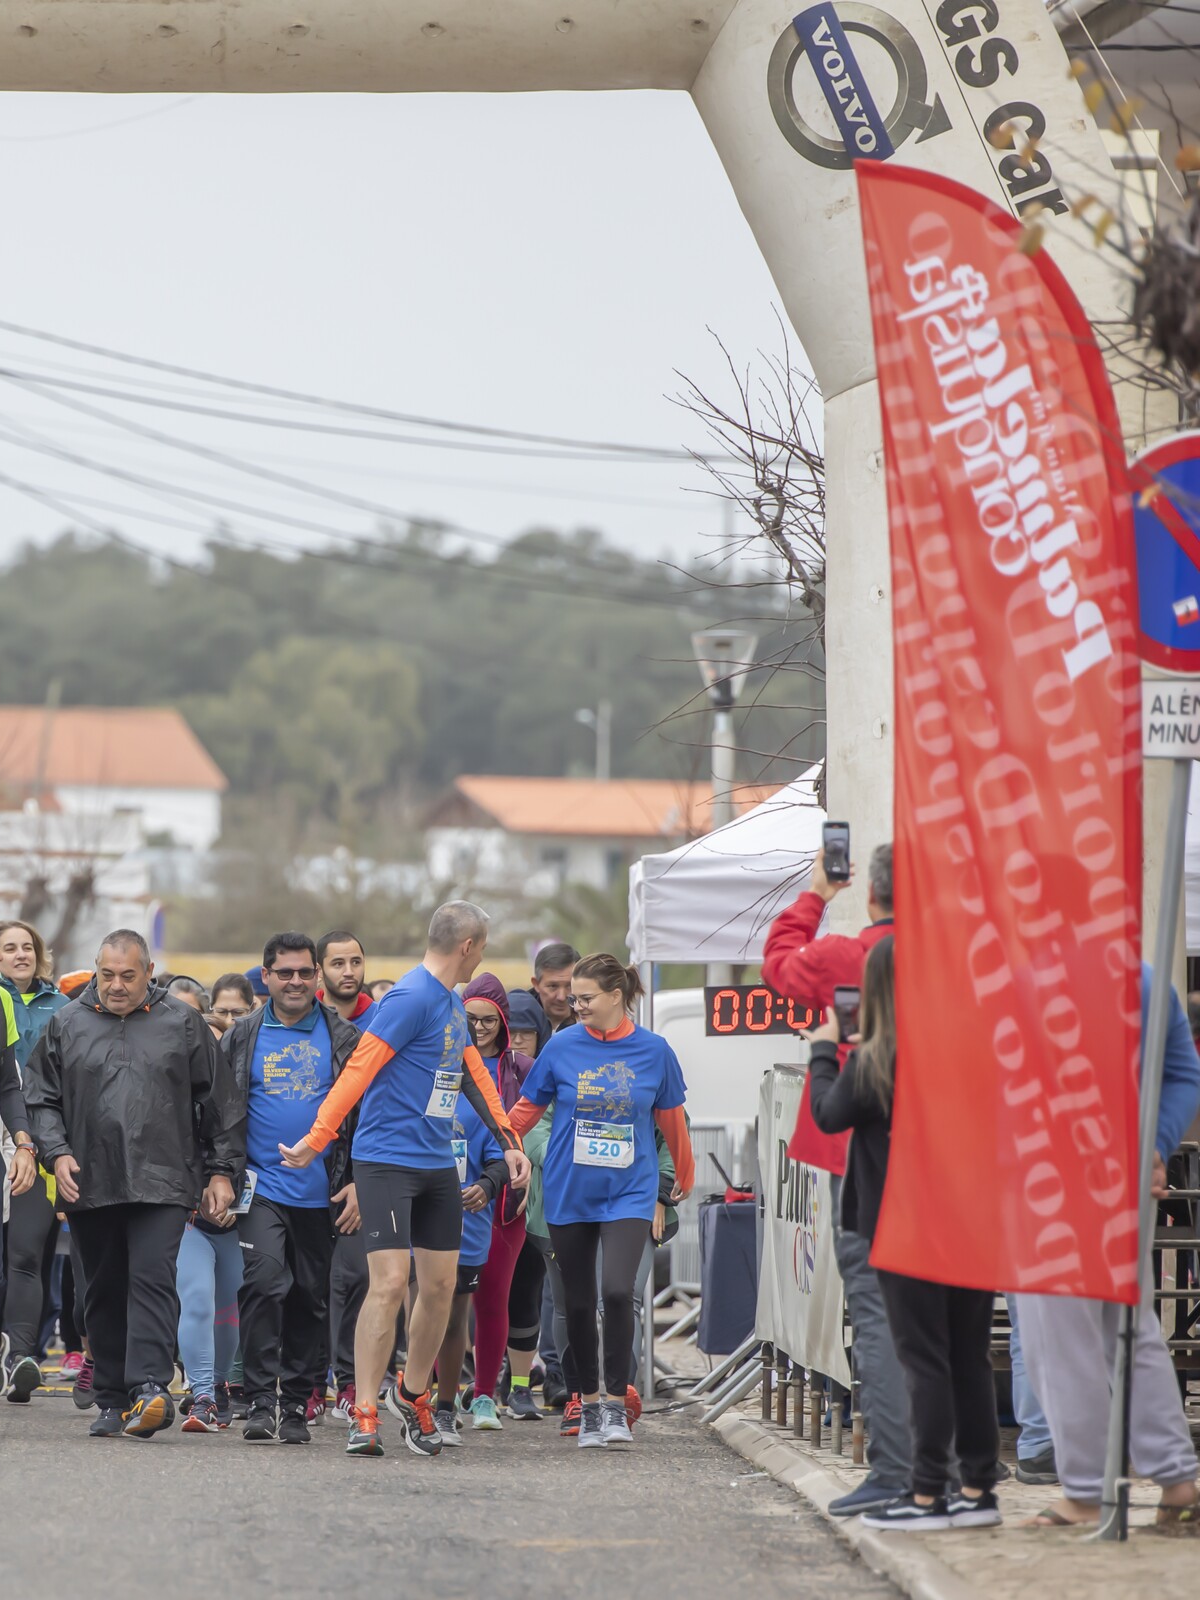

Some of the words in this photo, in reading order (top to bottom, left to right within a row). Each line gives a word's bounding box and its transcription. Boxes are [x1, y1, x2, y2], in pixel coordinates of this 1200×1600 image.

[811, 15, 877, 153] VOLVO
[935, 0, 1019, 89] GS
[983, 101, 1070, 218] Car
[713, 988, 823, 1032] 00:0
[588, 1140, 620, 1157] 520
